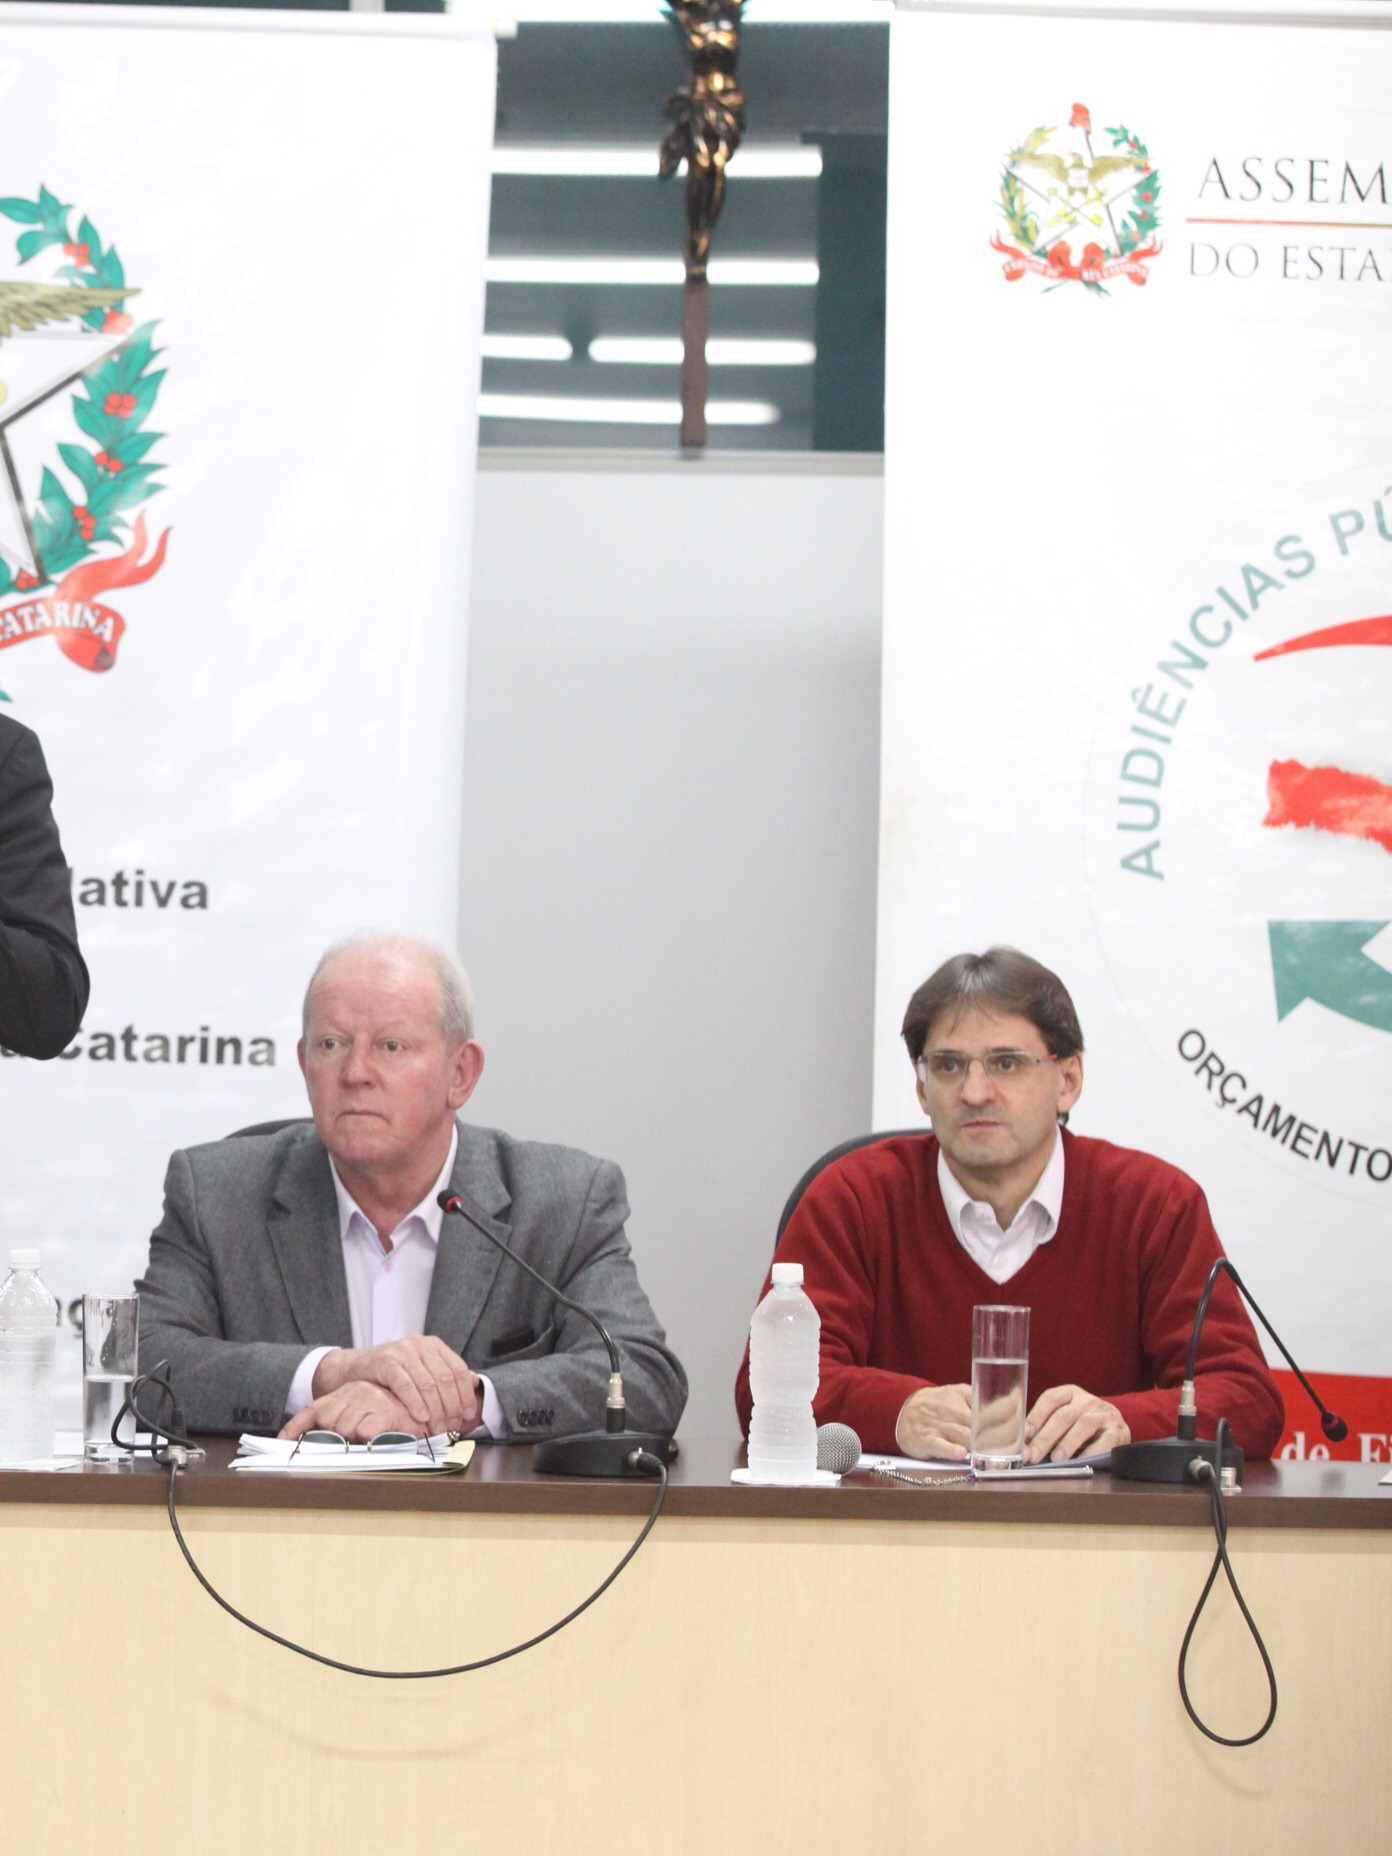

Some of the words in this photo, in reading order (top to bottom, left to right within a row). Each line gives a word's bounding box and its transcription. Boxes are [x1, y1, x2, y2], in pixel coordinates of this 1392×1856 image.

[1196, 156, 1392, 204] ASSEM
[1190, 243, 1259, 278] DO
[1281, 246, 1392, 281] ESTA
[1116, 533, 1317, 881] AUDIÊNCIAS
[1177, 1029, 1392, 1182] ORÇAMENTO
[1357, 1433, 1392, 1463] F
